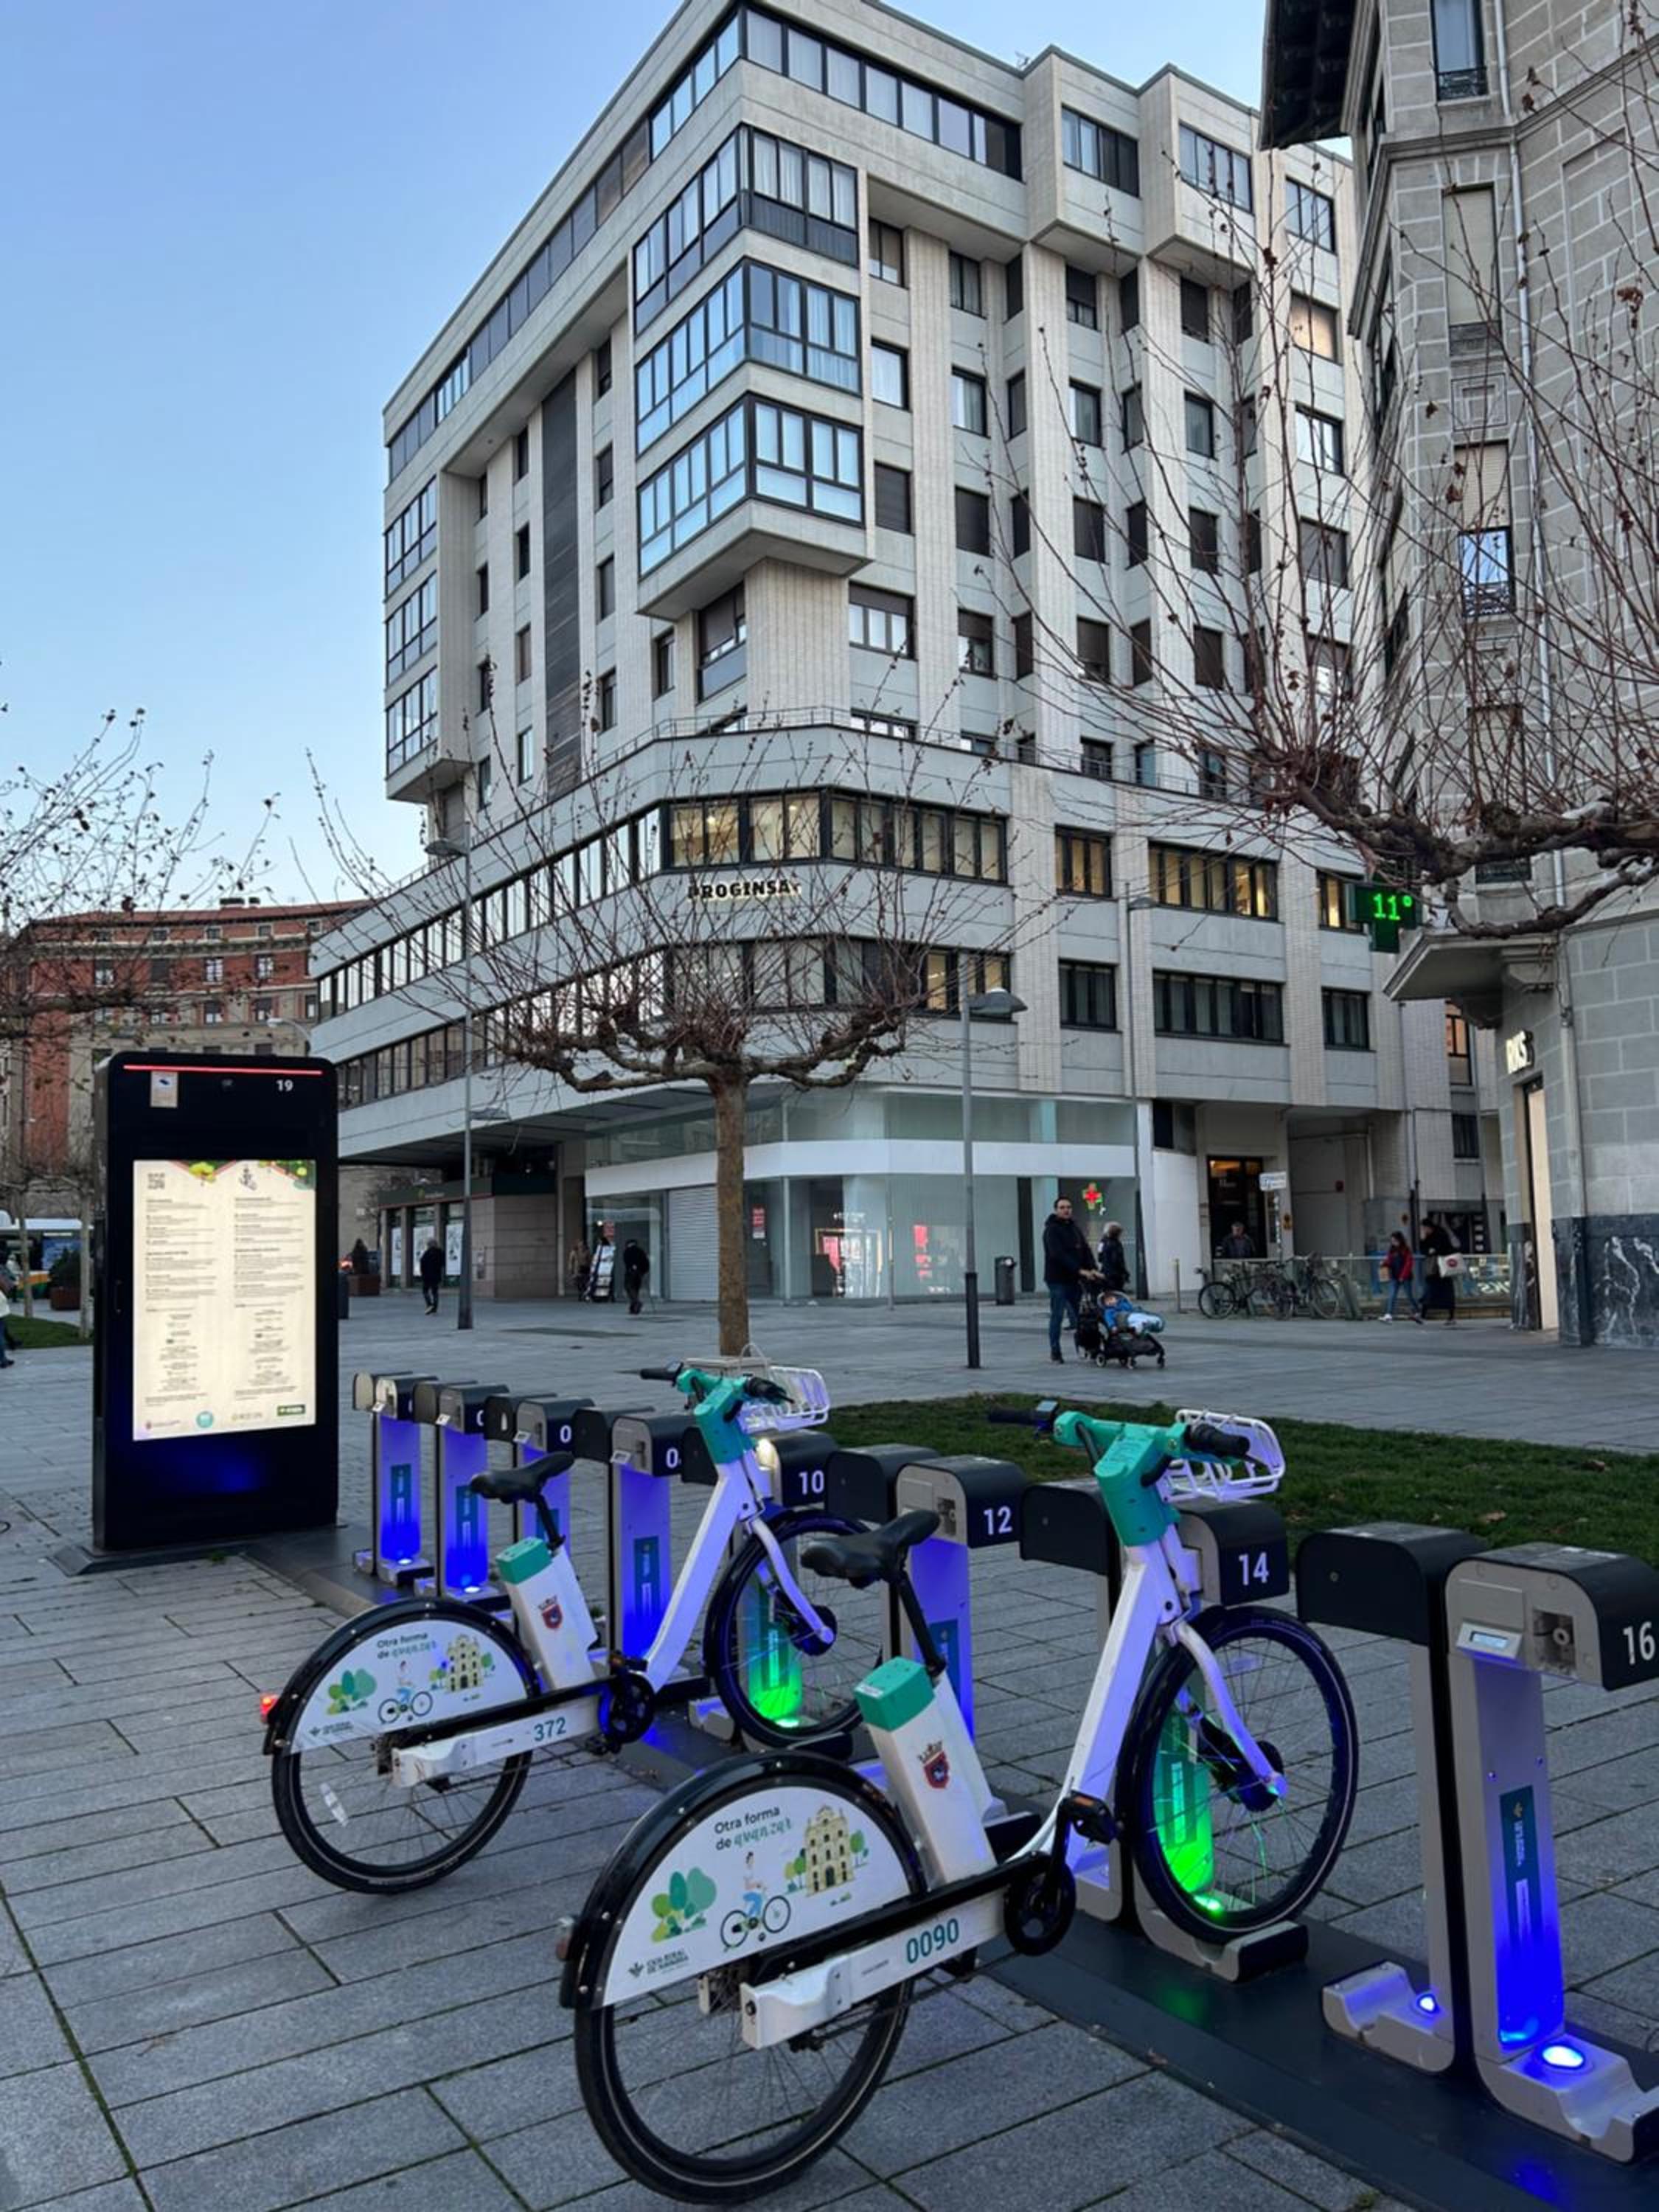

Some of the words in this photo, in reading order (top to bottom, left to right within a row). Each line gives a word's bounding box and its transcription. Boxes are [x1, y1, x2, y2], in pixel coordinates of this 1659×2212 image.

[276, 1079, 294, 1092] 19
[799, 1470, 825, 1495] 10
[983, 1505, 1013, 1536] 12
[1238, 1551, 1270, 1586] 14
[1622, 1621, 1656, 1666] 16
[533, 1716, 566, 1742] 372
[714, 1818, 742, 1835] Otra
[745, 1806, 780, 1826] forma
[715, 1837, 732, 1851] de
[906, 1918, 959, 1964] 0090
